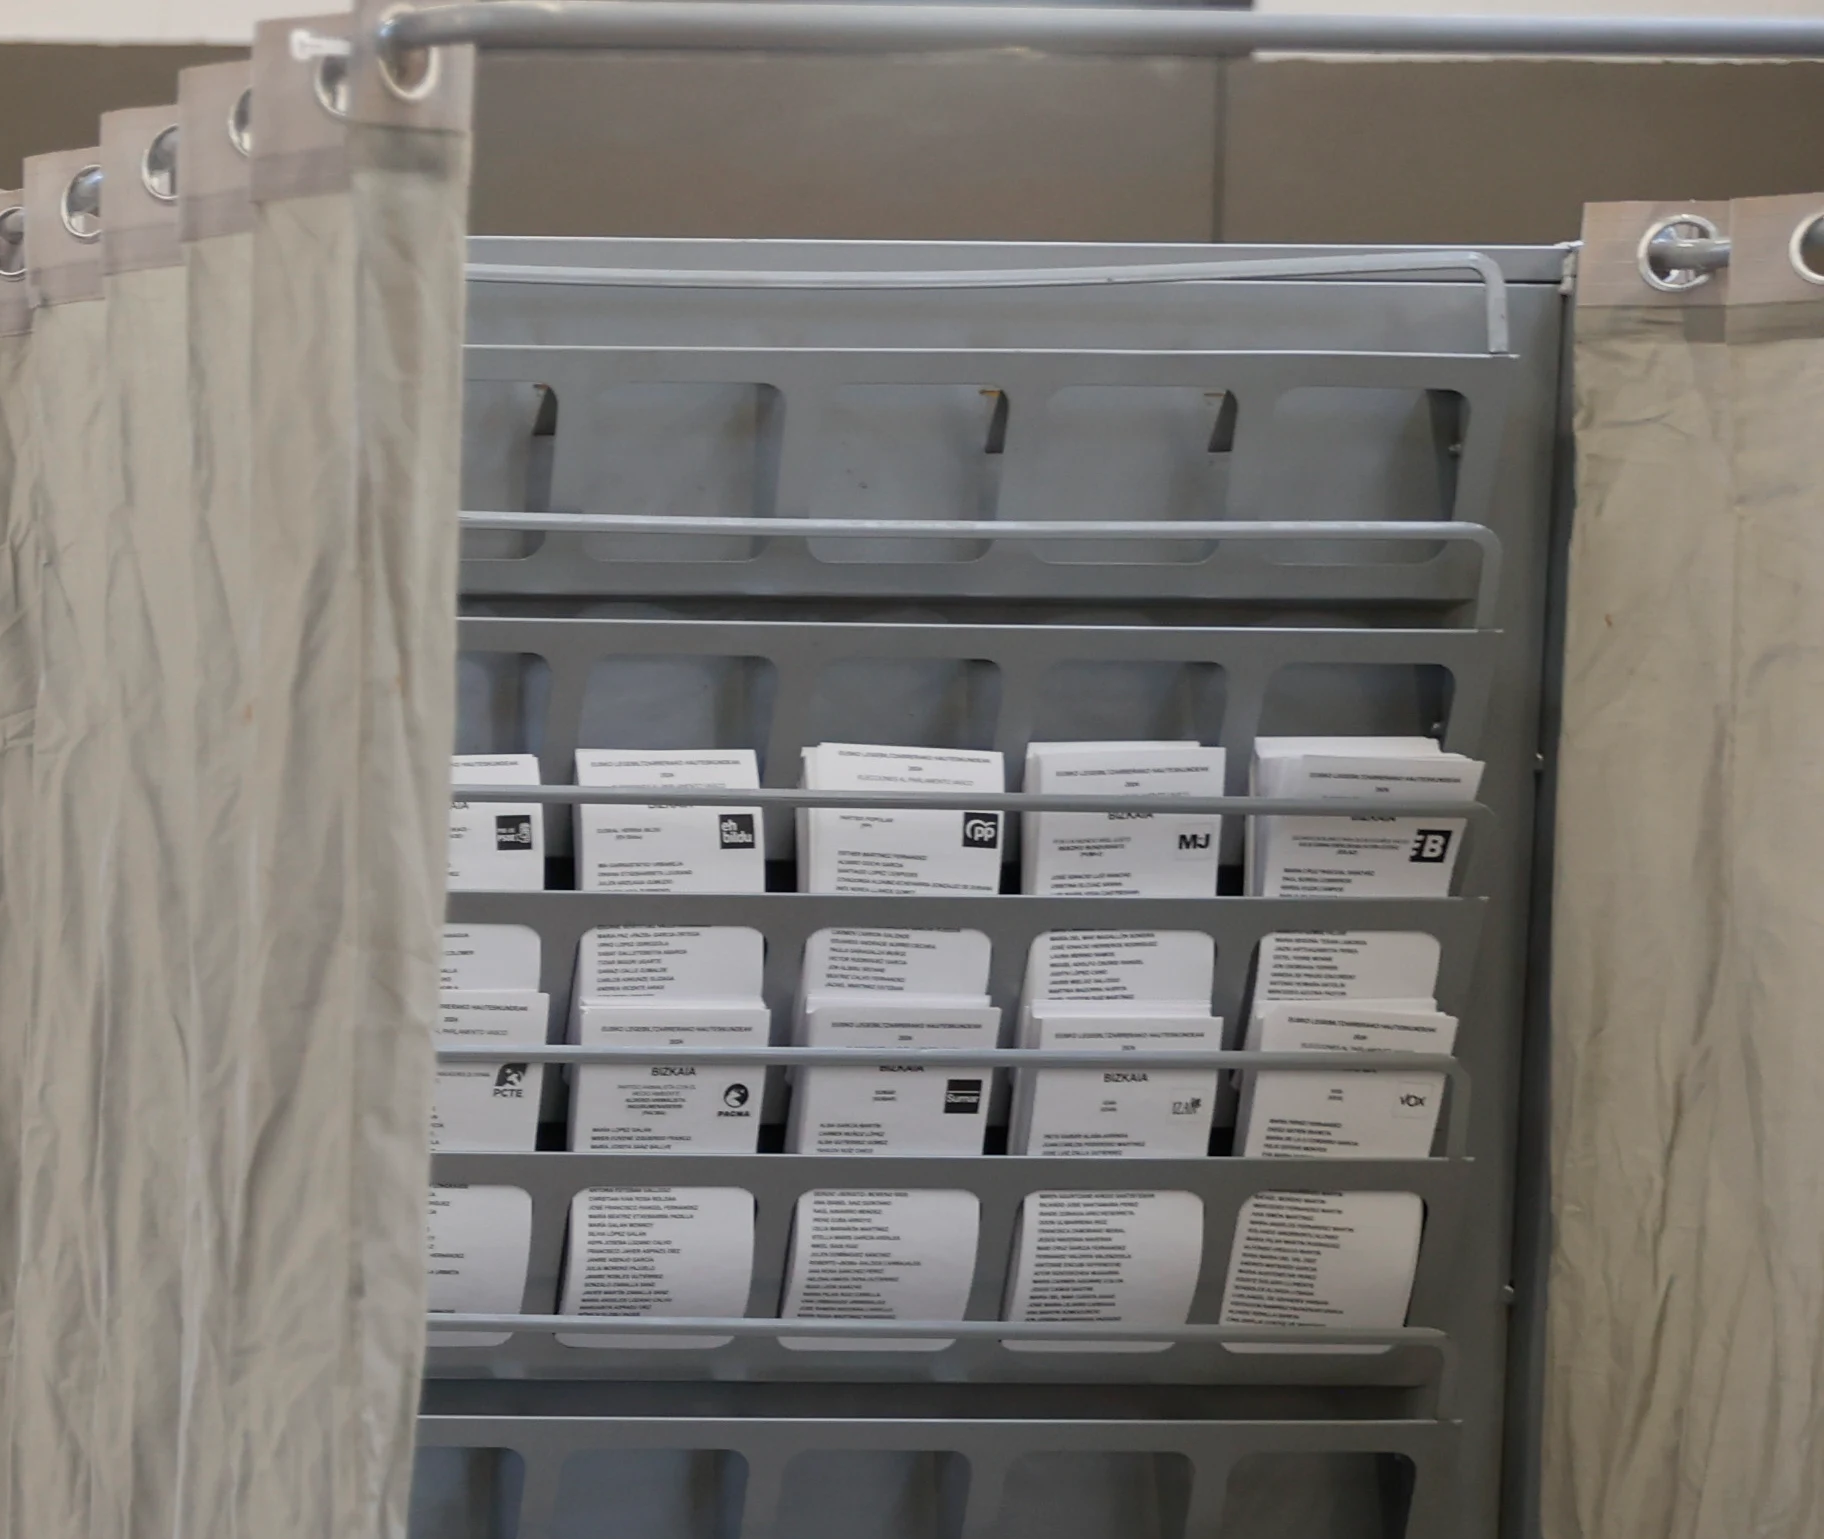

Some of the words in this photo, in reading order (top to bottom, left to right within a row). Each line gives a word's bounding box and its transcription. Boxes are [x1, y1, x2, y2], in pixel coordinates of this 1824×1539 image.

[721, 819, 737, 832] eh
[722, 831, 753, 844] bildu
[651, 1067, 697, 1077] BIZKAIA
[1104, 1073, 1149, 1083] BIZKAIA
[492, 1088, 524, 1098] PCTE
